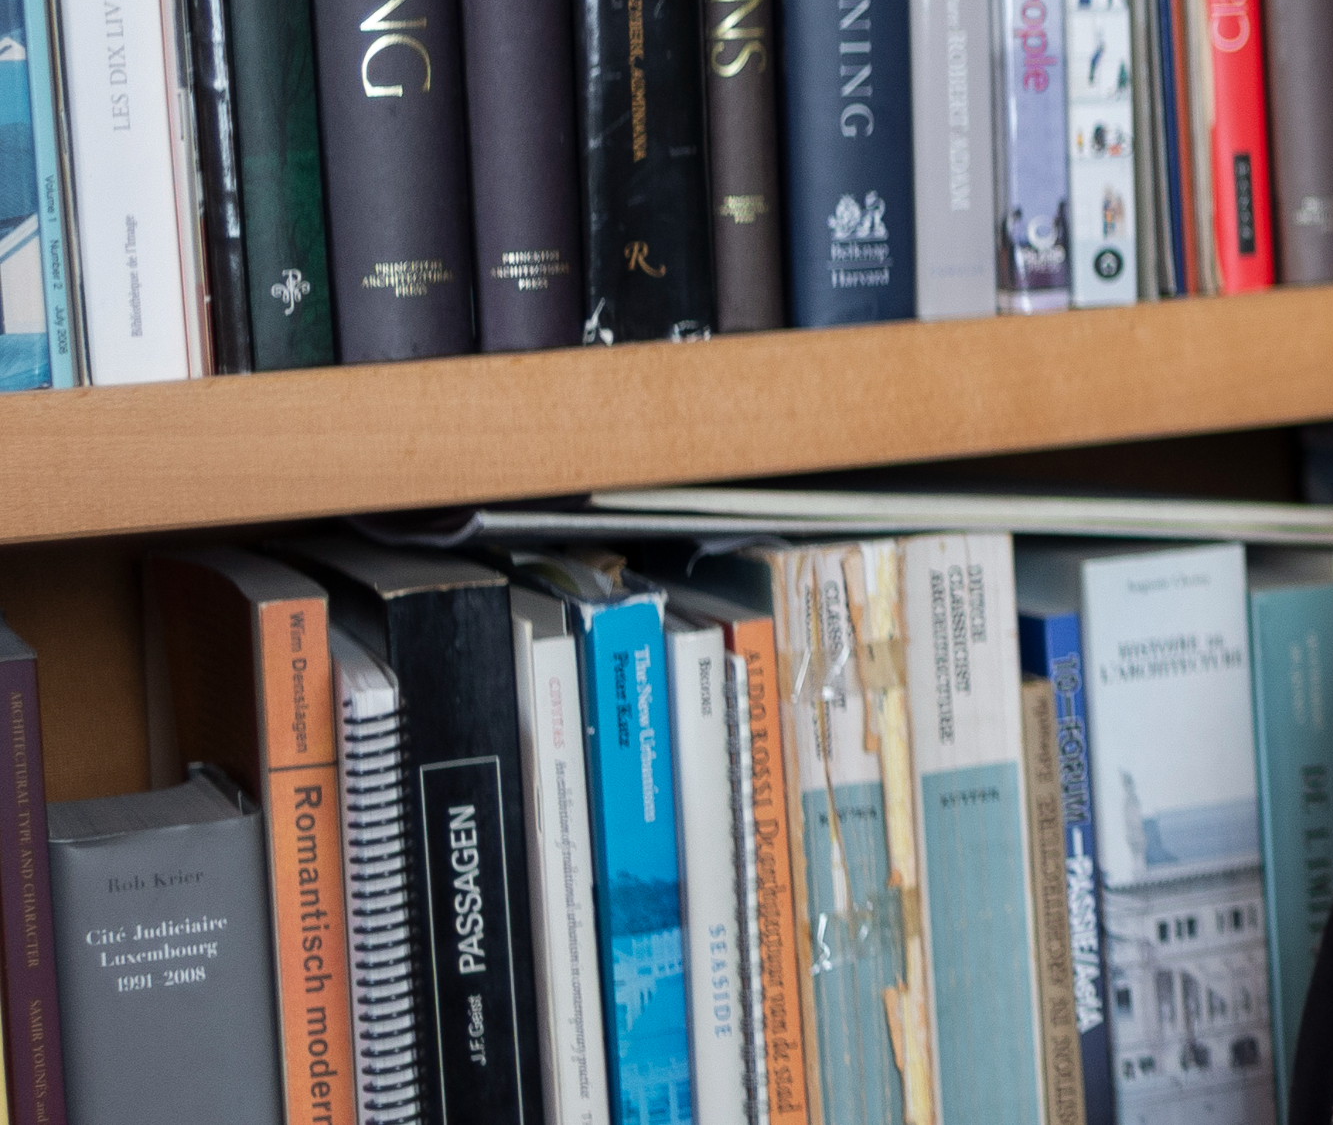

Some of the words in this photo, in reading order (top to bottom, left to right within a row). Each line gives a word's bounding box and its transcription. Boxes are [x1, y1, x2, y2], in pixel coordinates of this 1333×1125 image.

[106, 46, 128, 87] DIX
[108, 92, 131, 132] LES
[45, 174, 56, 215] Volume
[50, 240, 60, 276] Number
[624, 241, 667, 277] R
[55, 304, 66, 328] July
[289, 610, 307, 653] Wim
[634, 645, 651, 684] The
[744, 648, 772, 722] ALDO
[291, 657, 311, 755] Denslagen
[637, 684, 653, 727] New
[10, 691, 30, 807] ARCHITECTURAL
[750, 727, 775, 811] ROSSI
[639, 729, 658, 823] Urbanism
[17, 809, 32, 846] TYPE
[19, 850, 34, 880] AND
[106, 875, 146, 895] Rob
[153, 868, 207, 891] Krier
[294, 785, 333, 994] Romantisch
[448, 804, 487, 974] PASSAGEN
[21, 882, 40, 968] CHARACTER
[85, 925, 127, 948] Cité
[132, 913, 229, 942] Judiciaire
[100, 938, 219, 969] Luxembourg
[709, 922, 733, 1040] SEASIDE
[28, 999, 43, 1043] SAMIR
[36, 1101, 48, 1123] and
